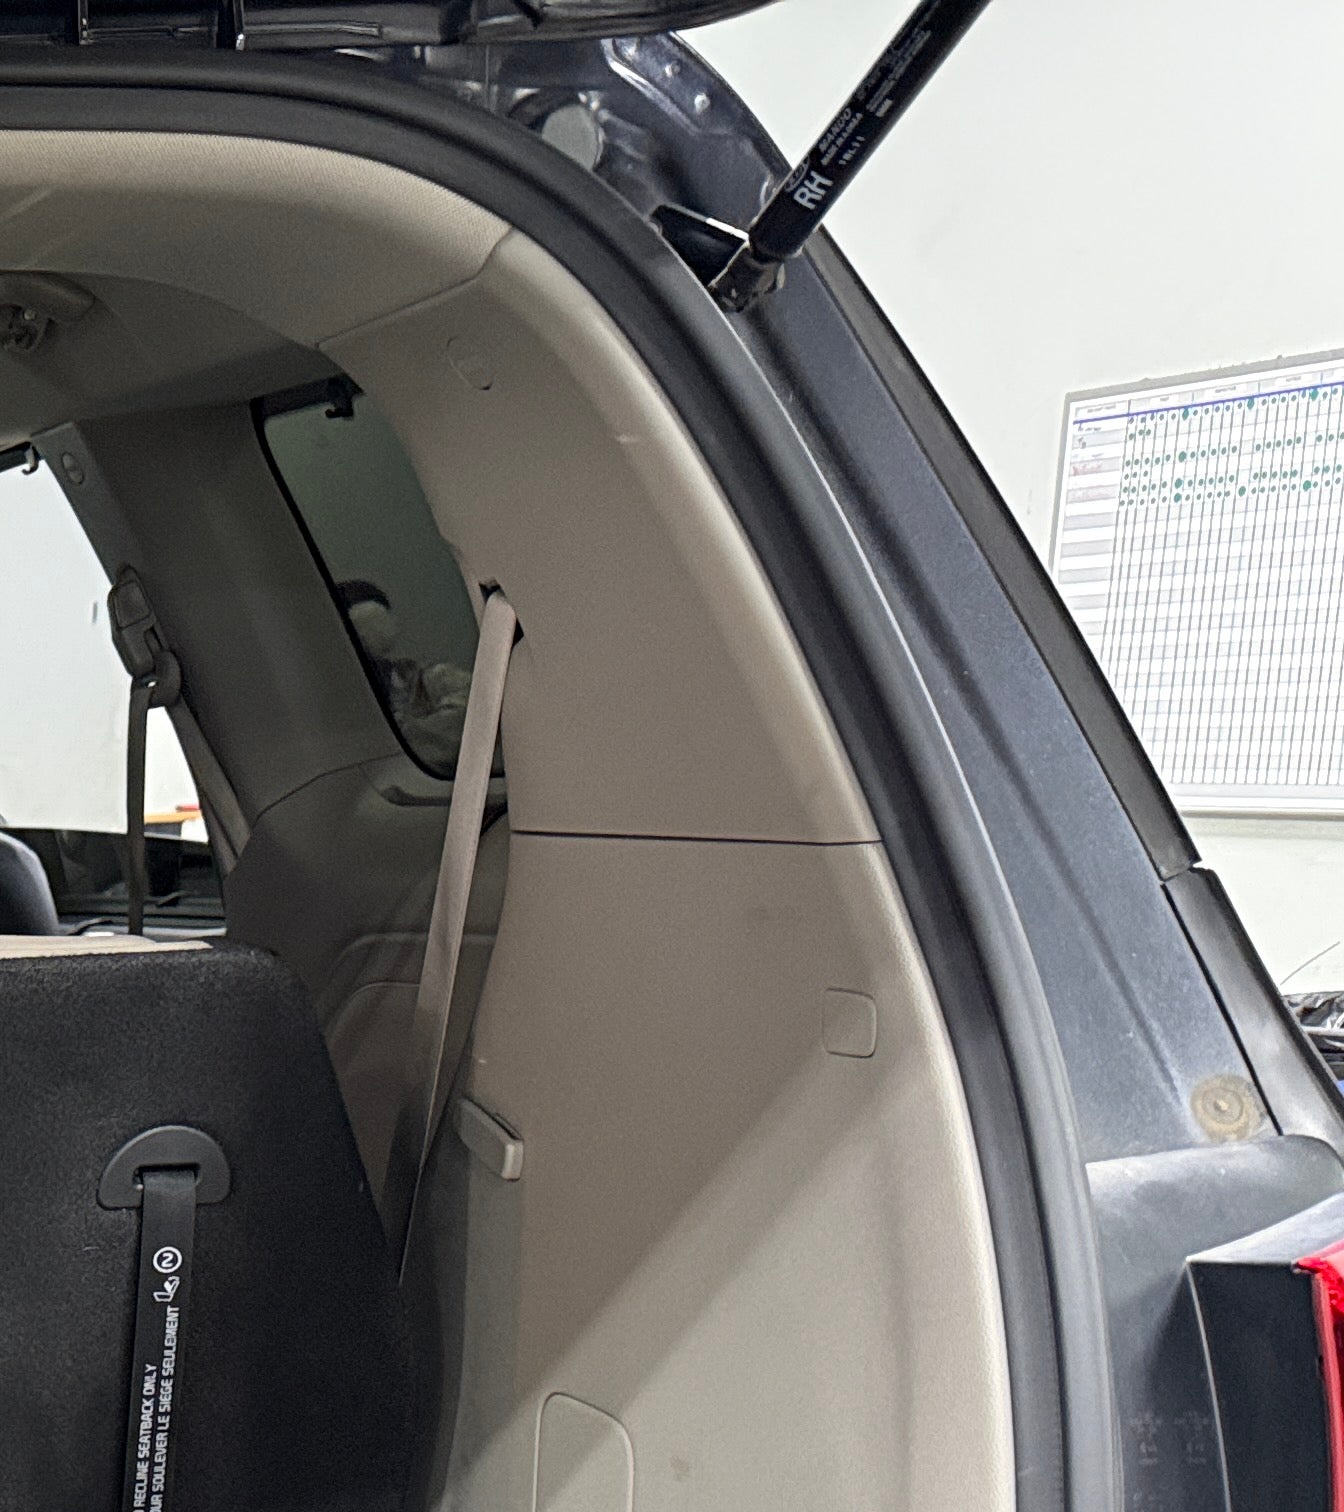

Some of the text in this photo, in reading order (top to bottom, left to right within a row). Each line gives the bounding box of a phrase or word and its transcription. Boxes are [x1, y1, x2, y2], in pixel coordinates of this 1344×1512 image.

[793, 170, 833, 210] RH
[162, 1304, 180, 1376] SEULEMENT
[144, 1363, 158, 1397] ONLY
[138, 1398, 154, 1459] SEATBACK
[157, 1414, 171, 1430] LE
[134, 1460, 149, 1509] RECLINE
[151, 1431, 168, 1491] SOULEVER
